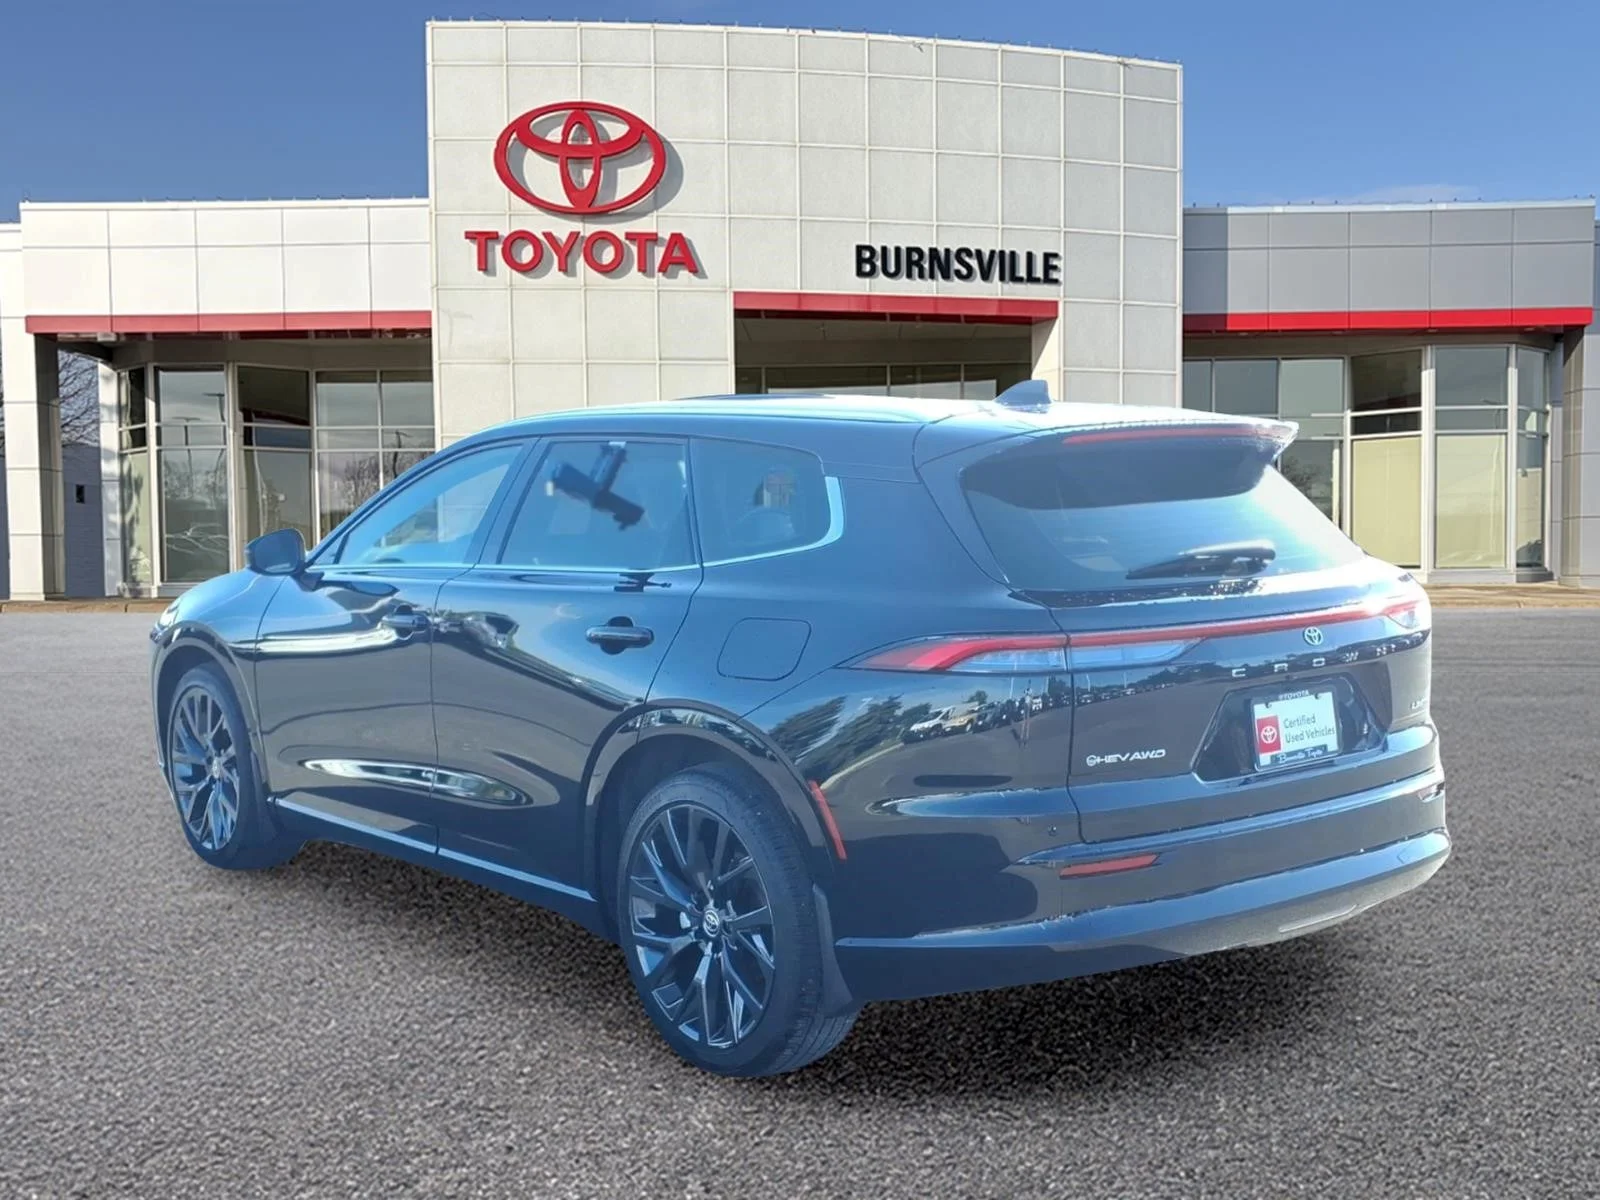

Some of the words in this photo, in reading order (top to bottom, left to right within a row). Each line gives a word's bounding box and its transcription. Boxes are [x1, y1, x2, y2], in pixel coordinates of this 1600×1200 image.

[464, 229, 699, 274] TOYOTA
[855, 244, 1061, 285] BURNSVILLE
[1283, 713, 1316, 729] Certified
[1285, 730, 1305, 743] Used
[1305, 726, 1336, 740] Vehicles
